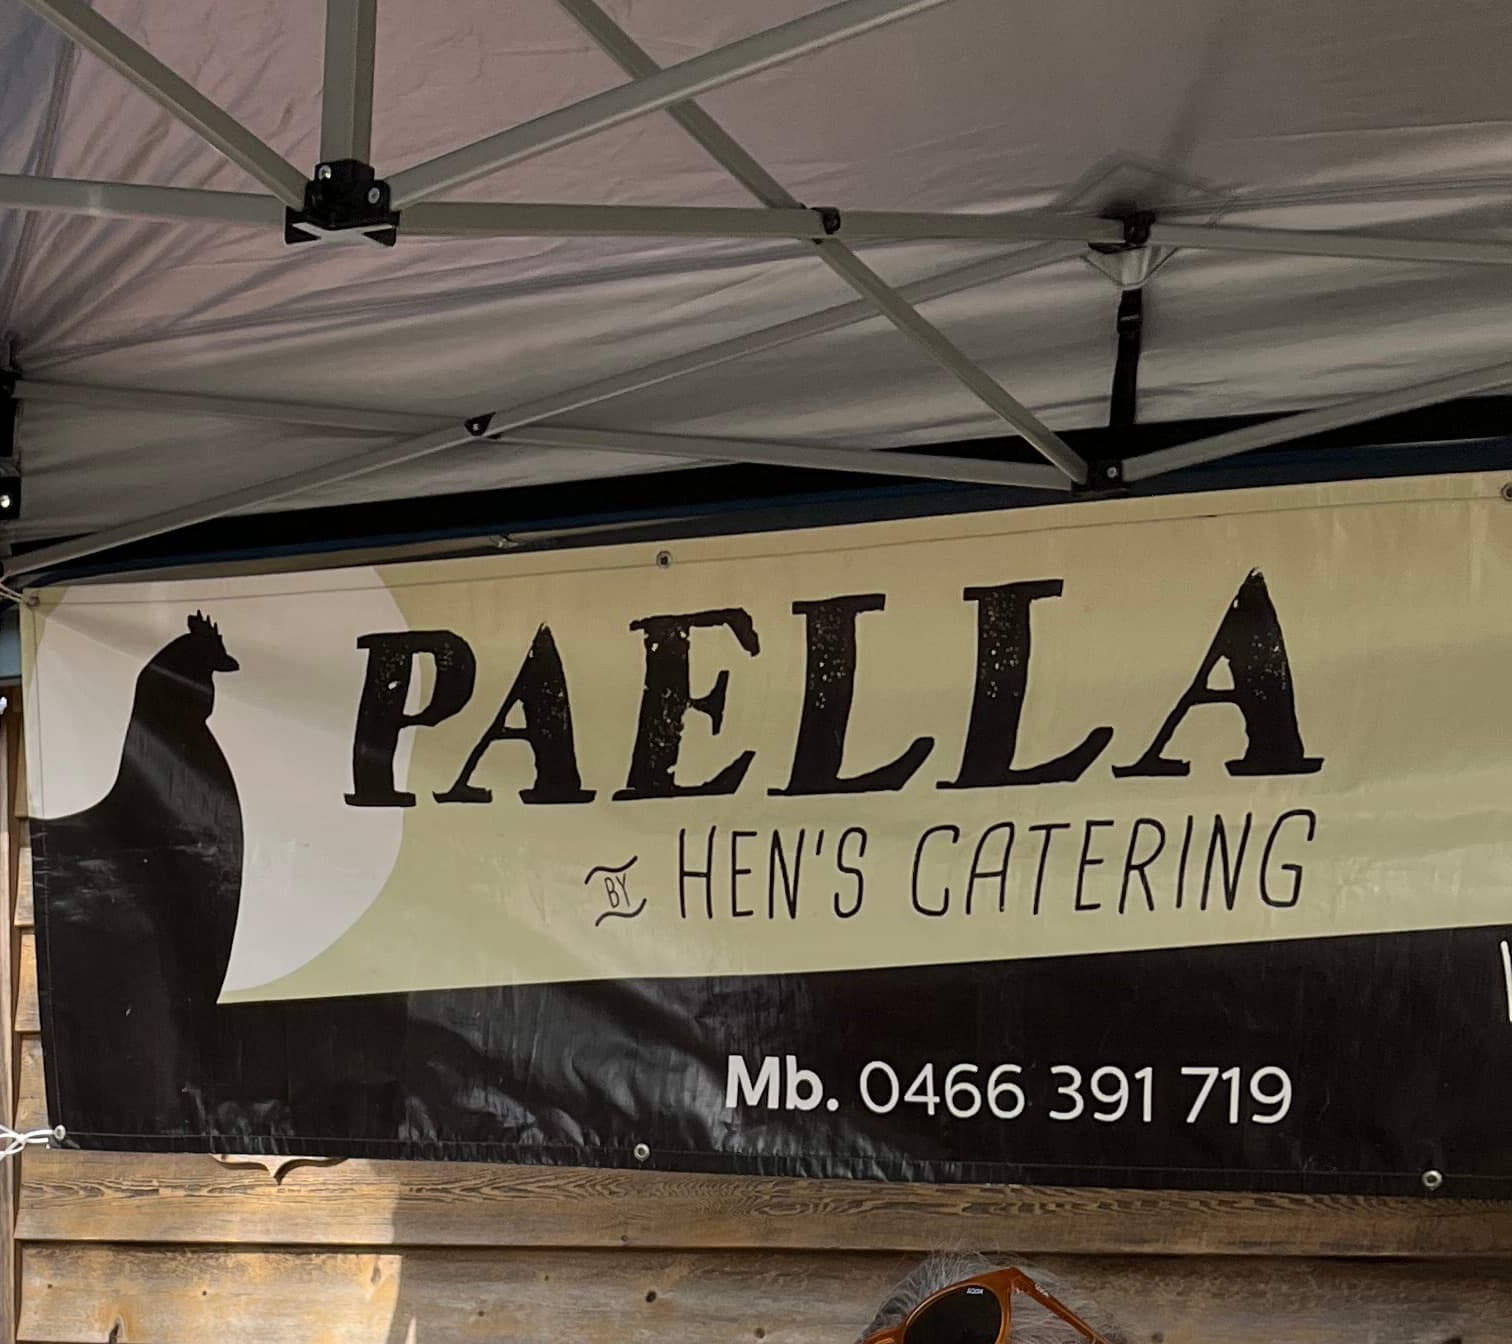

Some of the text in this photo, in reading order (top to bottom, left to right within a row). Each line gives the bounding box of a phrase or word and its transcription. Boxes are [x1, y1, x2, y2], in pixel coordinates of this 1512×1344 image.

[343, 567, 1325, 808] PAELLA
[604, 808, 1316, 920] BY HEN'S CATERING
[724, 1054, 1292, 1124] Mb. 0466 391 719
